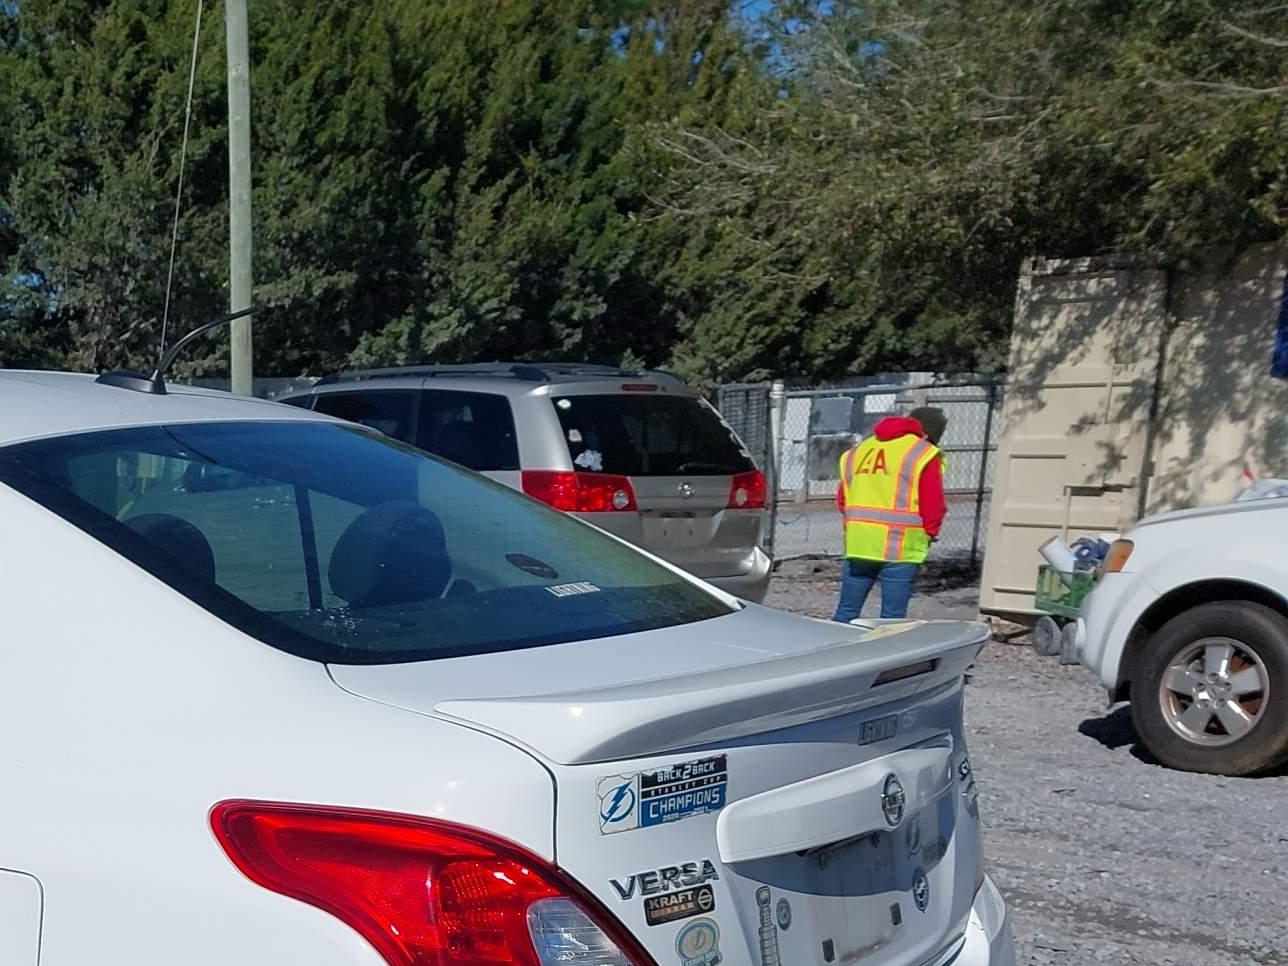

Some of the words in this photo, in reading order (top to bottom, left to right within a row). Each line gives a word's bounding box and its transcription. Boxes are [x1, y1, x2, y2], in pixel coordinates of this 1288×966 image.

[649, 788, 720, 818] CHAMPIONS
[608, 859, 720, 900] VERSA
[649, 891, 694, 910] KRAFT
